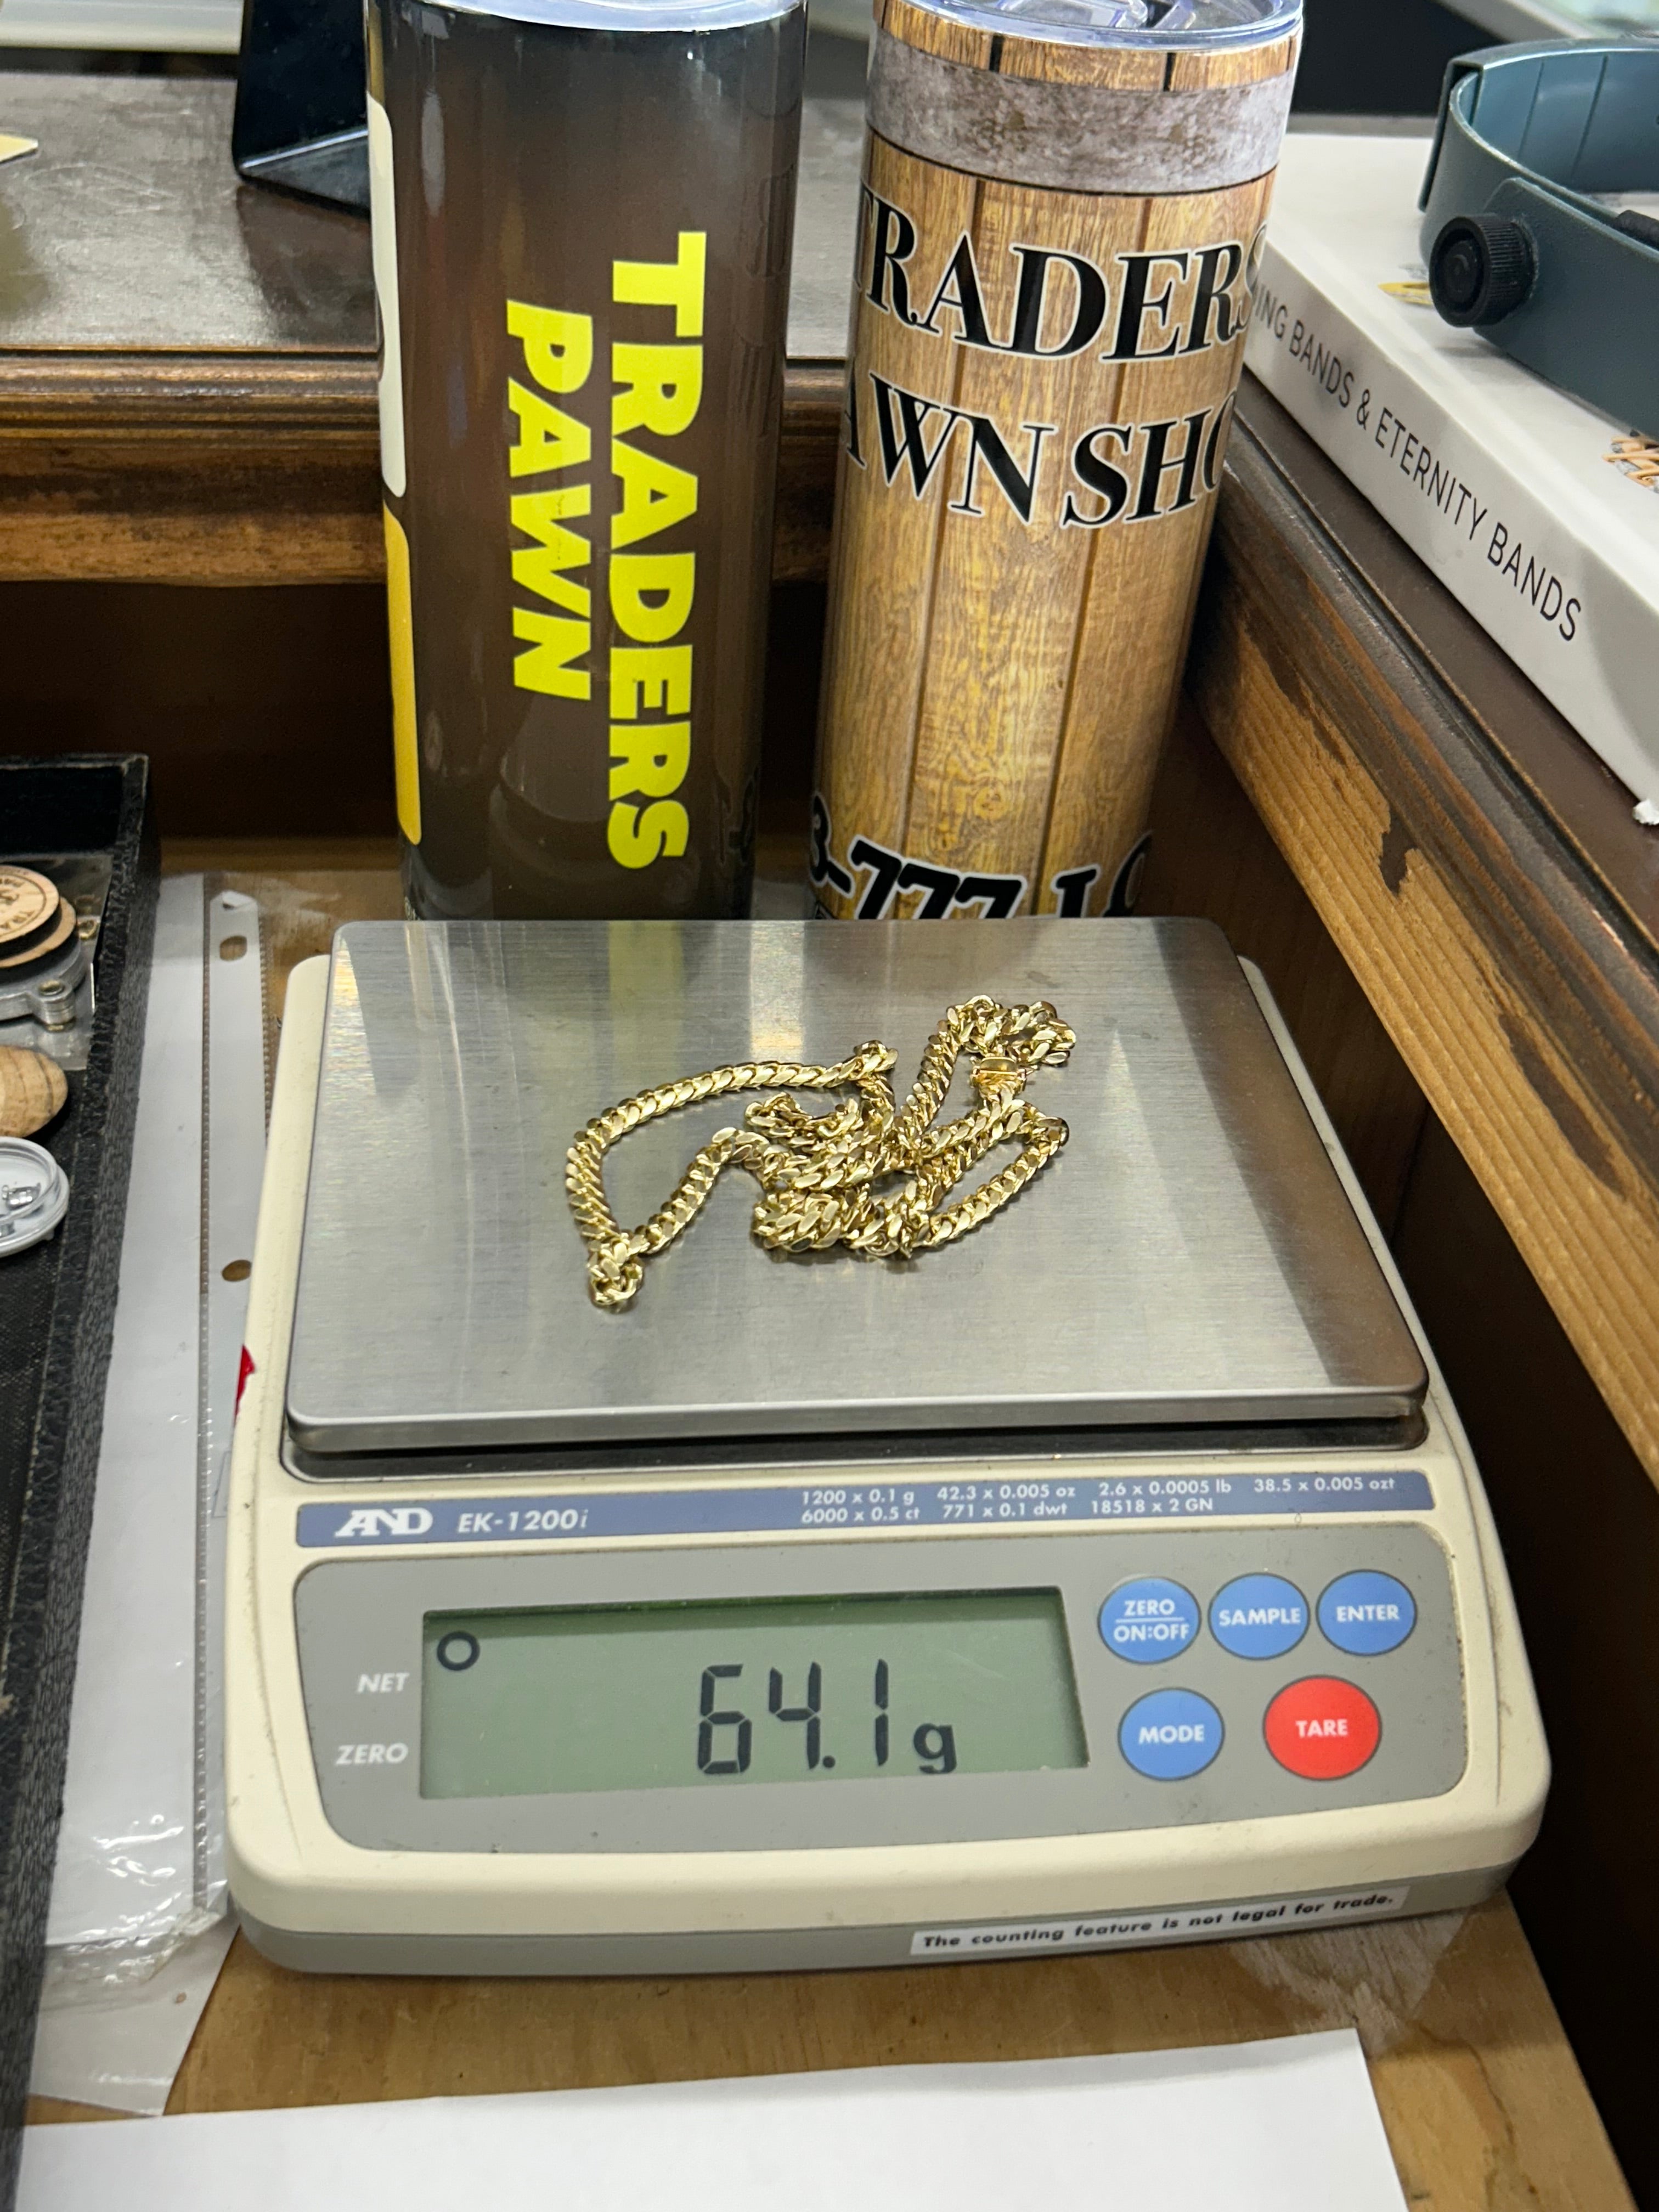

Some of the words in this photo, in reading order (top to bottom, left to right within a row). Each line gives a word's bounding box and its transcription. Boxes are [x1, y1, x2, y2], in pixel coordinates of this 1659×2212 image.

[1290, 320, 1353, 408] BANDS
[1357, 389, 1370, 430] &
[1375, 407, 1487, 540] ETERNITY
[1487, 522, 1581, 641] BANDS
[507, 299, 591, 700] PAWN
[608, 232, 707, 869] TRADERS
[937, 1485, 977, 1501] 42.3
[983, 1488, 994, 1499] x
[999, 1483, 1050, 1499] 0.005
[1056, 1486, 1076, 1498] oz
[1098, 1482, 1127, 1497] 2.6
[1132, 1485, 1143, 1496] x
[1148, 1480, 1210, 1496] 0.0005
[1215, 1479, 1232, 1493] lb
[1254, 1478, 1292, 1493] 38.5
[1298, 1481, 1309, 1491] x
[1314, 1476, 1364, 1491] 0.005
[1369, 1477, 1396, 1490] ozt
[803, 1489, 847, 1505] 1200
[852, 1492, 863, 1504] x
[869, 1488, 895, 1503] 0.1
[904, 1491, 915, 1506] g
[1091, 1499, 1146, 1514] 18518
[1152, 1502, 1163, 1513] x
[1169, 1498, 1180, 1512] 2
[1184, 1497, 1214, 1511] GN
[802, 1507, 849, 1523] 6000
[854, 1511, 865, 1522] x
[871, 1506, 899, 1522] 0.5
[905, 1506, 921, 1520] ct
[943, 1503, 974, 1519] 771
[983, 1506, 994, 1517] x
[999, 1502, 1026, 1517] 0.1
[1033, 1500, 1068, 1516] dwt
[456, 1509, 589, 1534] EK-1200i
[1125, 1599, 1176, 1617] ZERO
[1218, 1607, 1301, 1627] SAMPLE
[1335, 1604, 1400, 1622] ENTER
[357, 1672, 410, 1694] NET
[1138, 1724, 1205, 1745] MODE
[1295, 1718, 1348, 1738] TARE
[335, 1742, 409, 1765] ZERO
[924, 1935, 960, 1947] The
[972, 1928, 1064, 1945] counting
[1074, 1921, 1152, 1937] feature
[1161, 1917, 1178, 1929] is
[1188, 1914, 1223, 1926] not
[1232, 1905, 1287, 1921] legal
[1294, 1903, 1325, 1915] for
[1333, 1894, 1393, 1910] trade.
